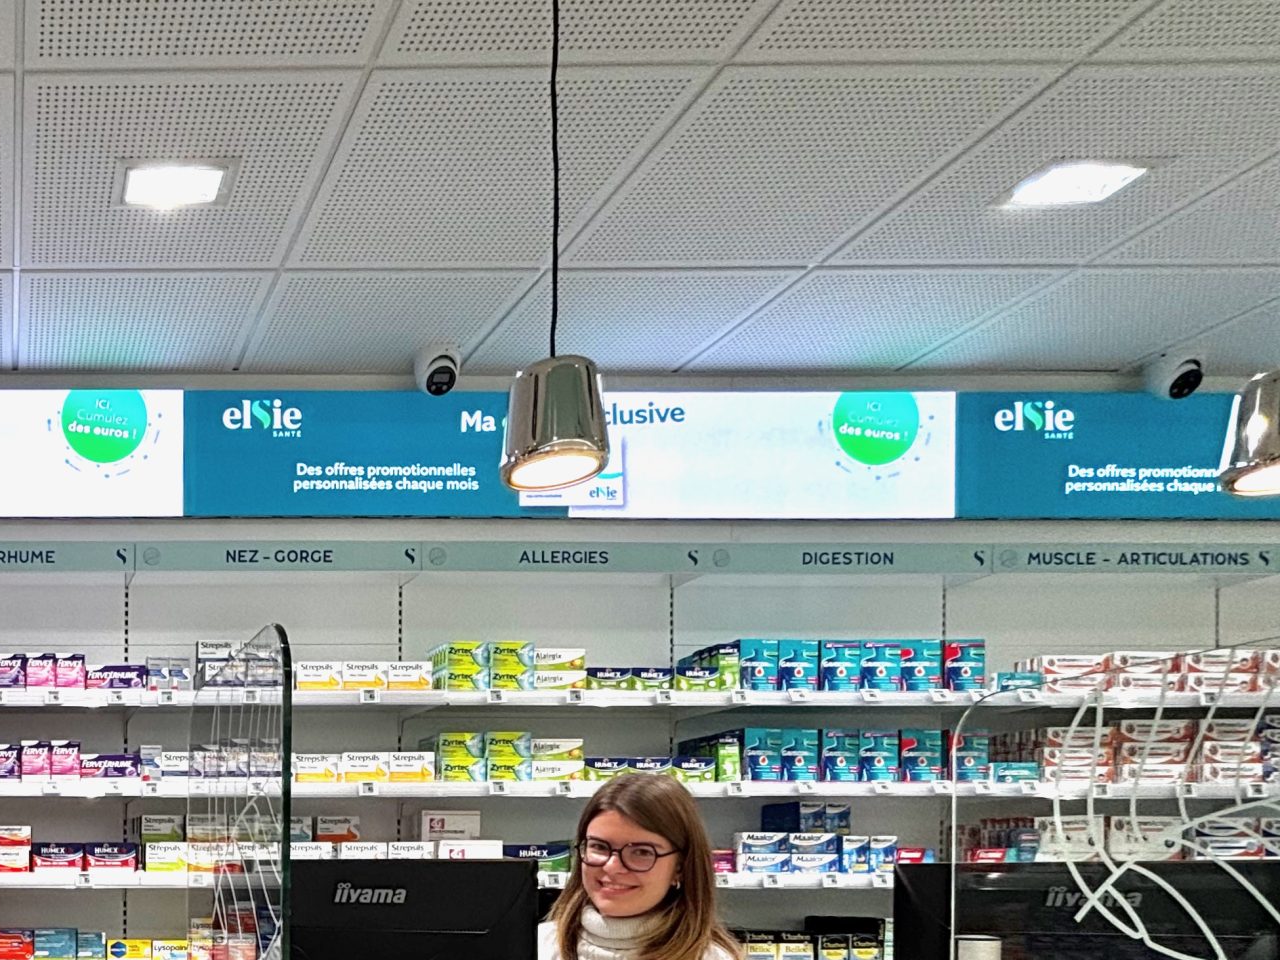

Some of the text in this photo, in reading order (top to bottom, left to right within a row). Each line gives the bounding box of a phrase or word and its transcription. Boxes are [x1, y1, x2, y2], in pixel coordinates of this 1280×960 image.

[460, 410, 496, 432] Ma
[68, 420, 91, 434] des
[93, 425, 129, 439] euros
[272, 430, 302, 438] SANTÉ
[839, 423, 901, 441] des euros
[296, 462, 476, 478] Des offres promotionnelles
[1068, 465, 1094, 478] Des
[1096, 464, 1136, 478] offres
[293, 477, 479, 493] personnalisées chaque mois
[1065, 479, 1215, 495] personnalisées chaque
[225, 550, 334, 564] NEZ GORGE
[519, 550, 609, 565] ALLERGIES
[802, 551, 894, 566] DIGESTION
[1027, 551, 1250, 565] MUSCLE ARTICULATIONS
[333, 882, 407, 904] iiyama
